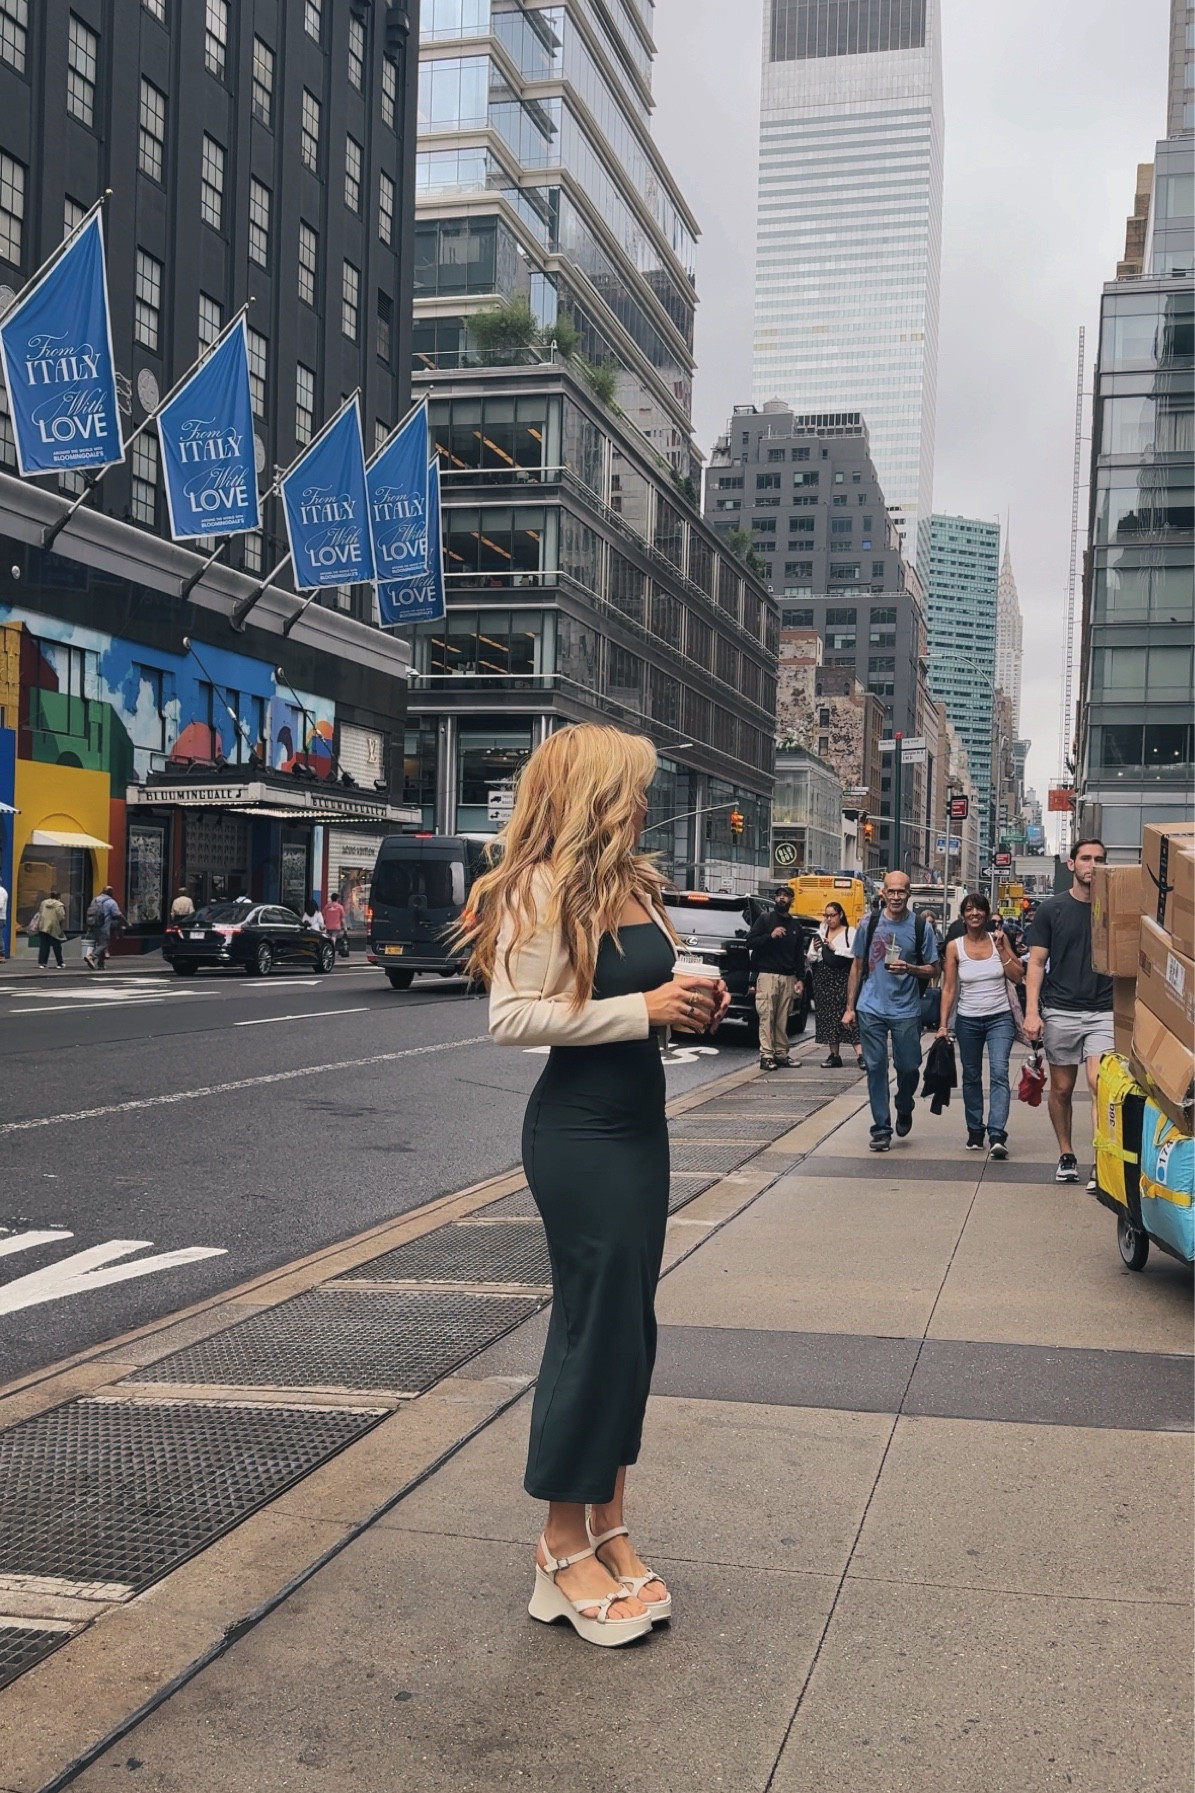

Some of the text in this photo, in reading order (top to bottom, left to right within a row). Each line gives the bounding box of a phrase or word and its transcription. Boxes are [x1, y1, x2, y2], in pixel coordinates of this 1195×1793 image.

[26, 331, 75, 361] From
[24, 353, 101, 386] ITALY
[62, 387, 108, 417] With
[38, 412, 108, 443] LOVE
[180, 417, 220, 441] From
[53, 450, 104, 462] BLOOMINGDALE'S
[178, 435, 244, 463] ITALY
[210, 464, 250, 490] With
[189, 486, 249, 513] LOVE
[300, 484, 336, 506] From
[374, 484, 407, 505] From
[300, 500, 356, 525] ITALY
[373, 498, 425, 522] ITALY
[327, 525, 362, 547] With
[399, 520, 427, 542] With
[309, 543, 362, 567] LOVE
[381, 538, 428, 562] LOVE
[391, 585, 437, 607] LOVE
